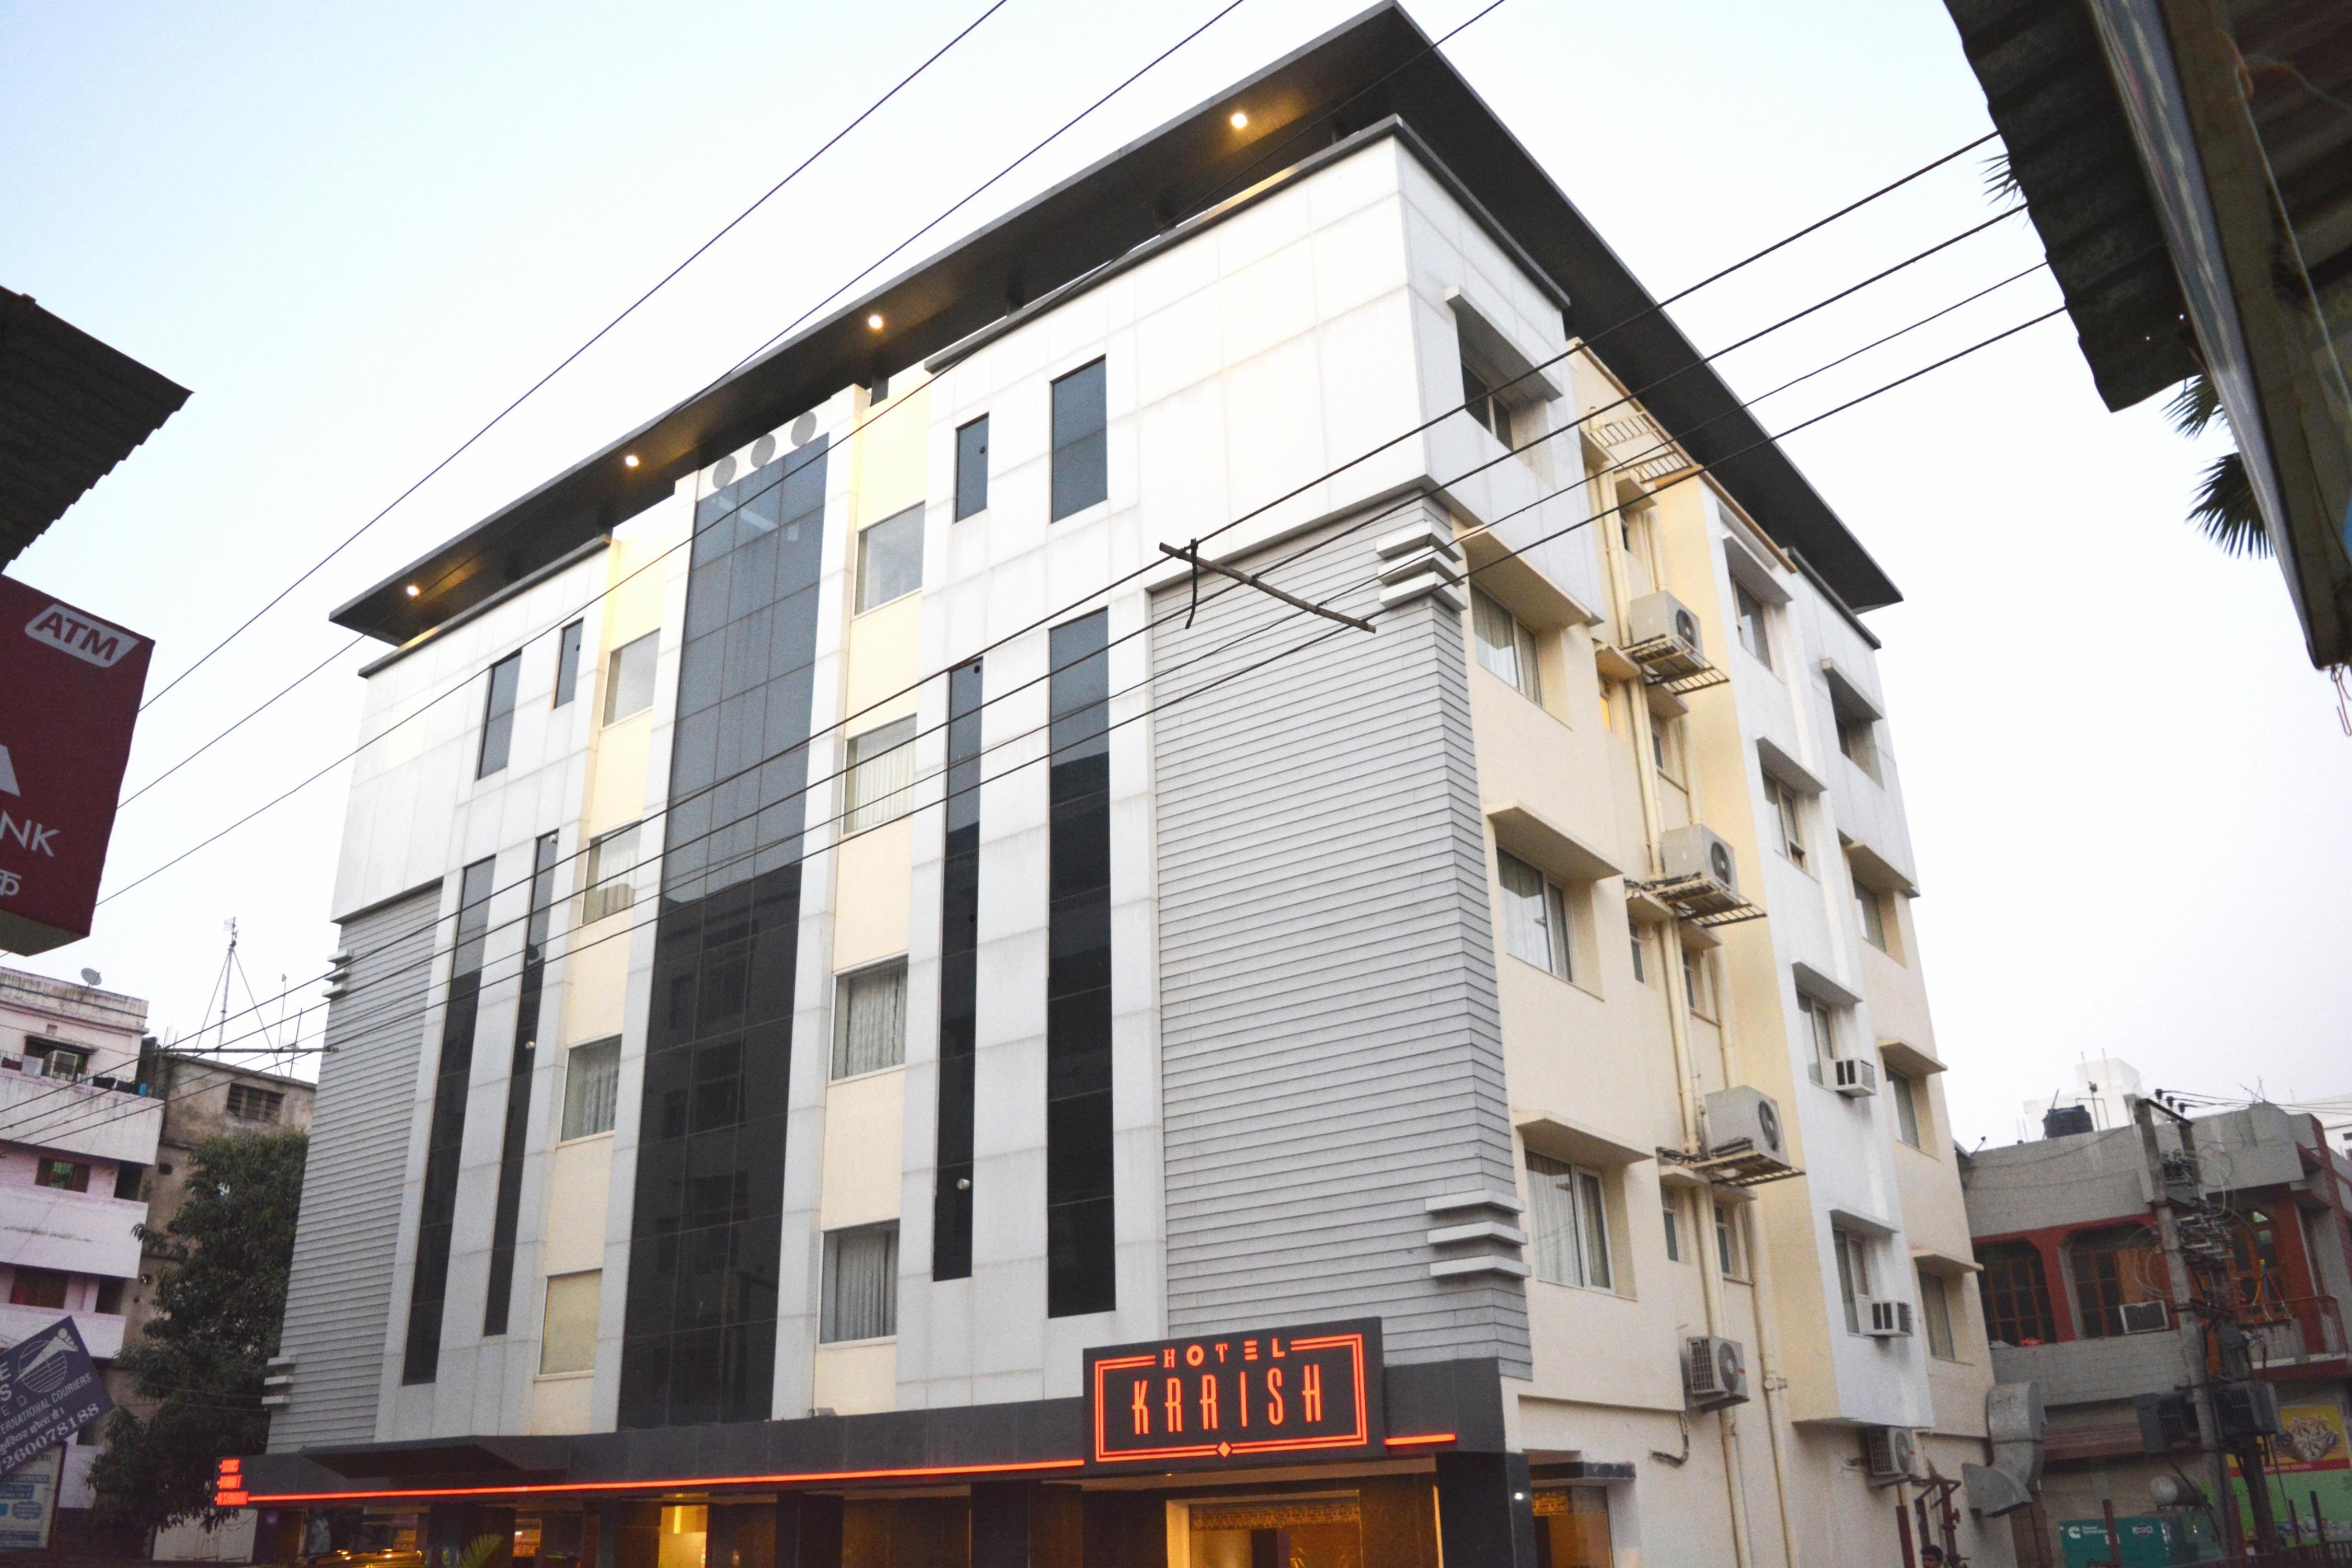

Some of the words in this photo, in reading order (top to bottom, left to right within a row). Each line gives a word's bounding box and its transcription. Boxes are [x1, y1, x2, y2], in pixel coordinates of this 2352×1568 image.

[33, 612, 120, 661] ATM
[1162, 1338, 1286, 1369] HOTEL
[51, 1373, 91, 1403] COURIERS
[1132, 1363, 1322, 1435] KRRISH
[0, 1403, 99, 1471] 260078188
